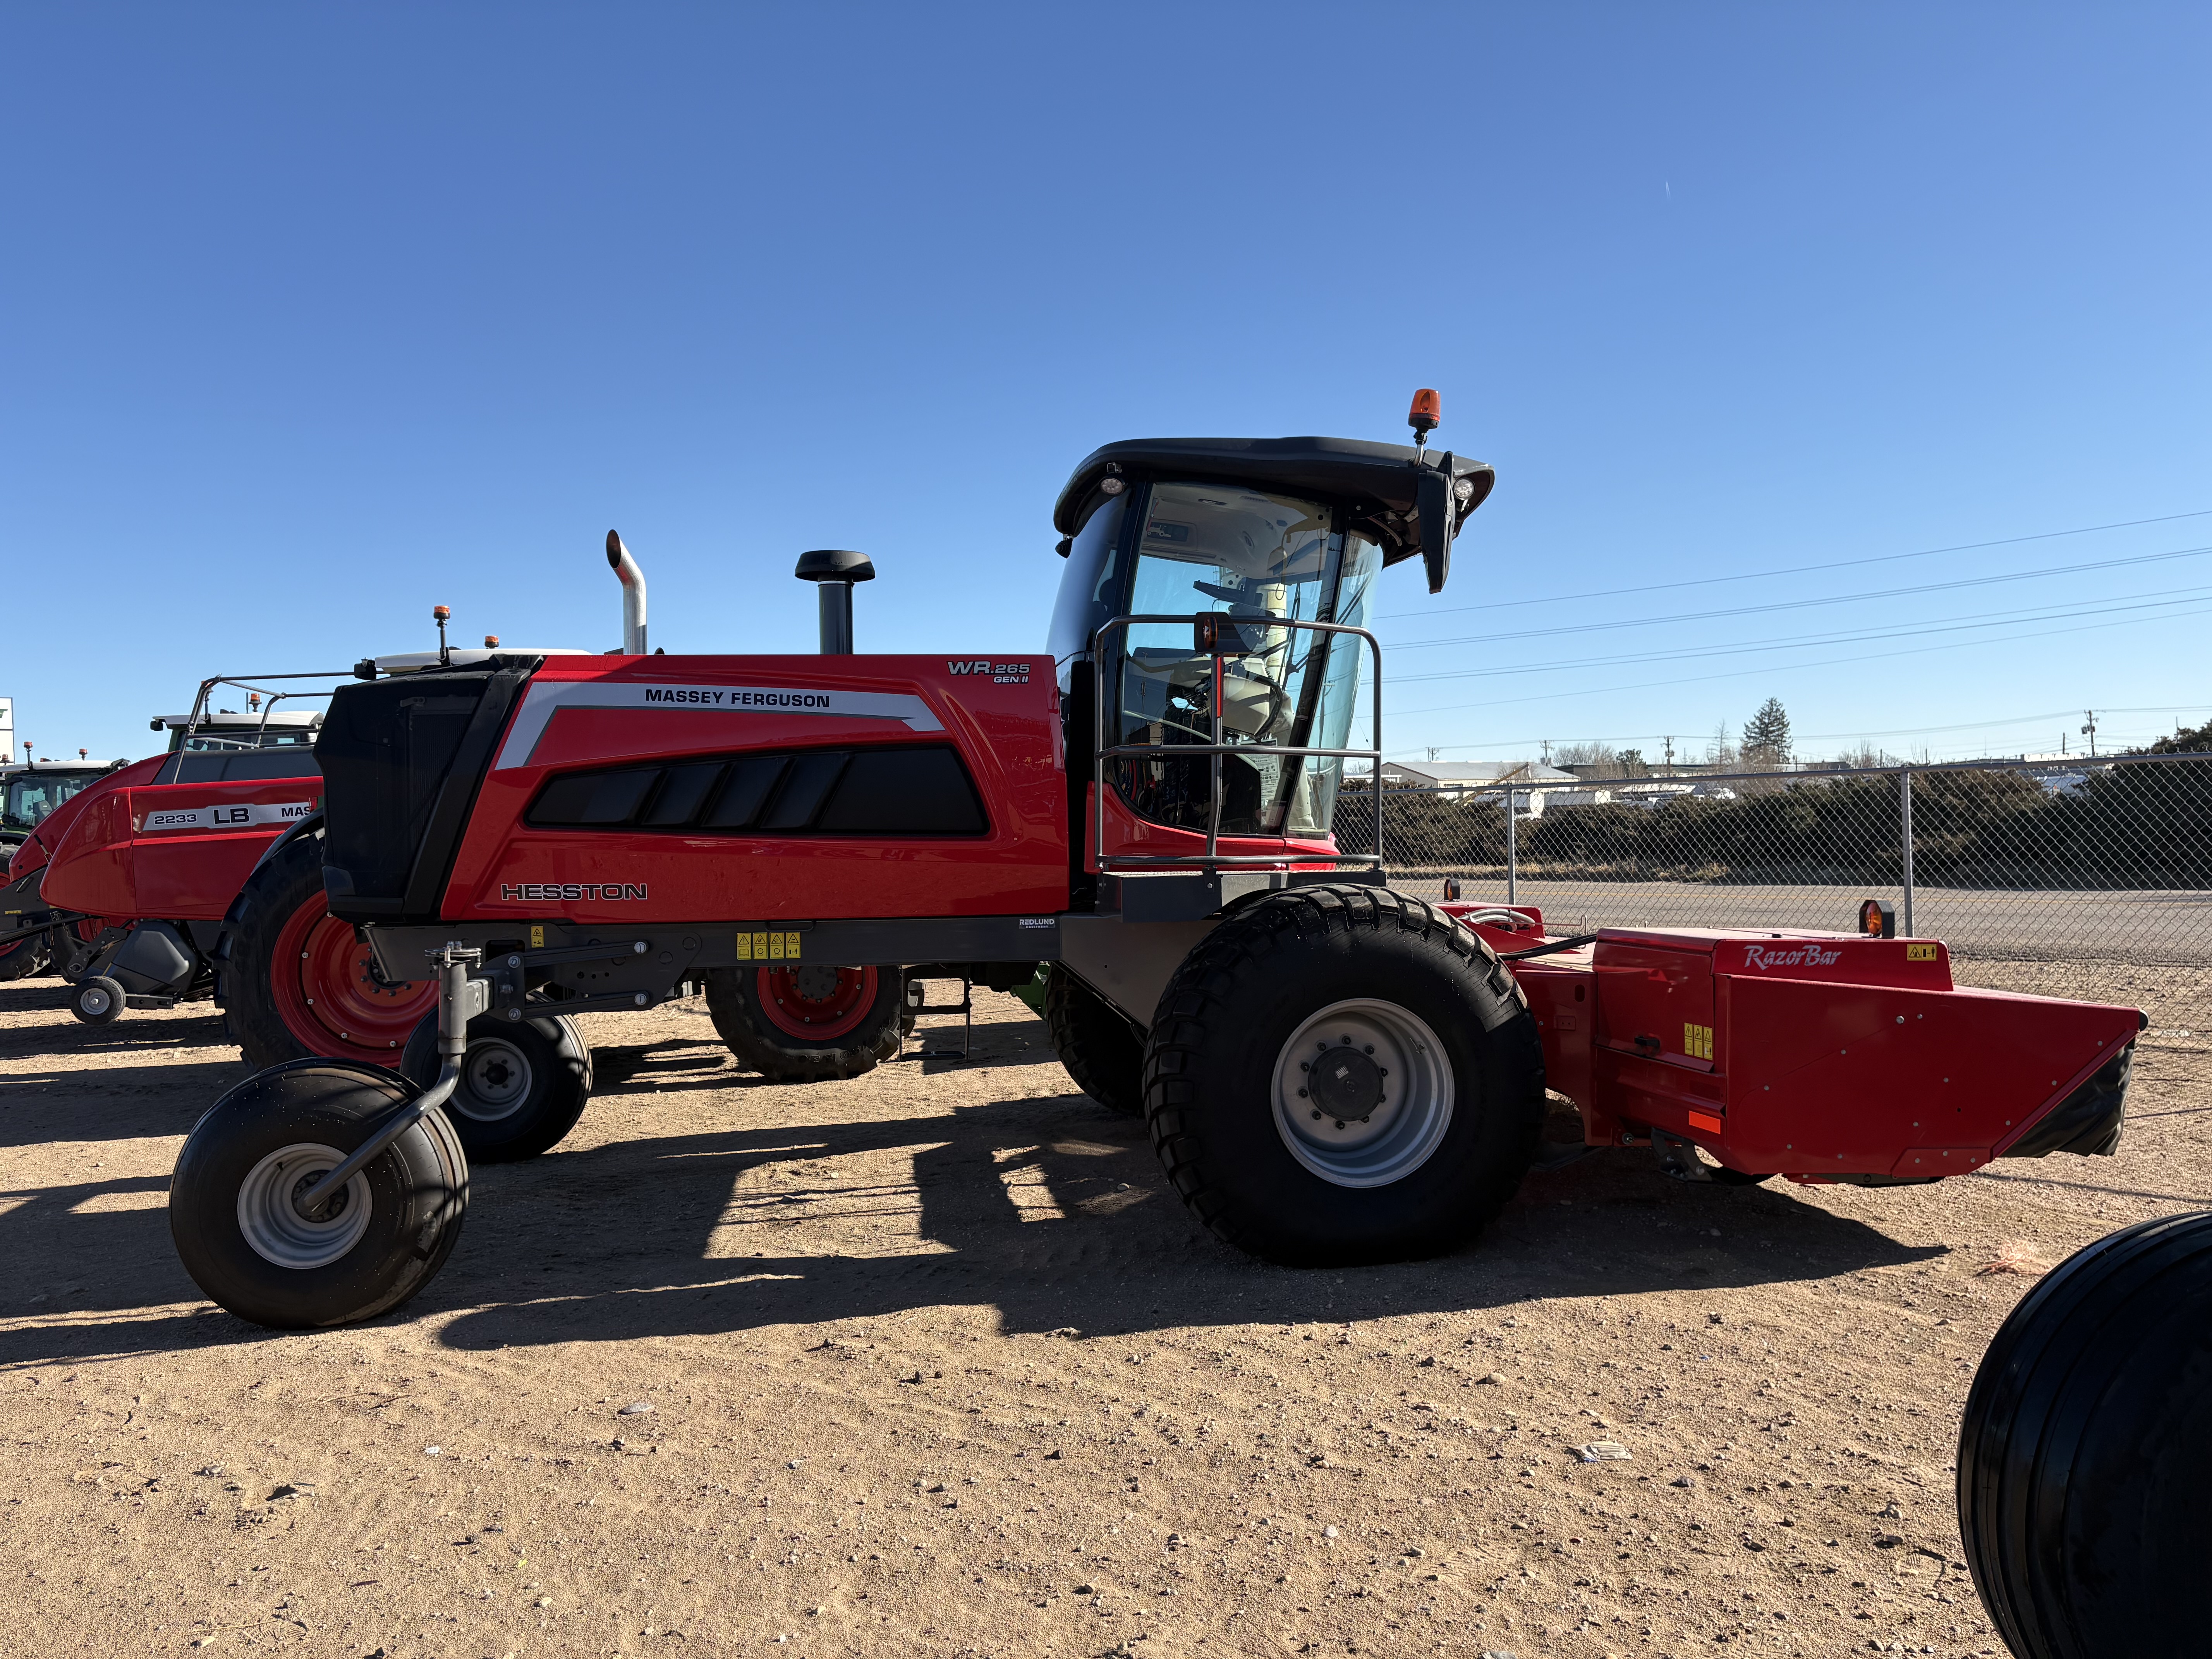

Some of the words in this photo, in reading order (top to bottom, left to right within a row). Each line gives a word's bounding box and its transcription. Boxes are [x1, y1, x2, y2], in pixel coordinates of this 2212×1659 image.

[645, 689, 724, 704] MASSEY
[731, 692, 830, 708] FERGUSON
[154, 814, 198, 825] 2233
[213, 807, 250, 824] LB
[501, 883, 647, 900] HESSTON
